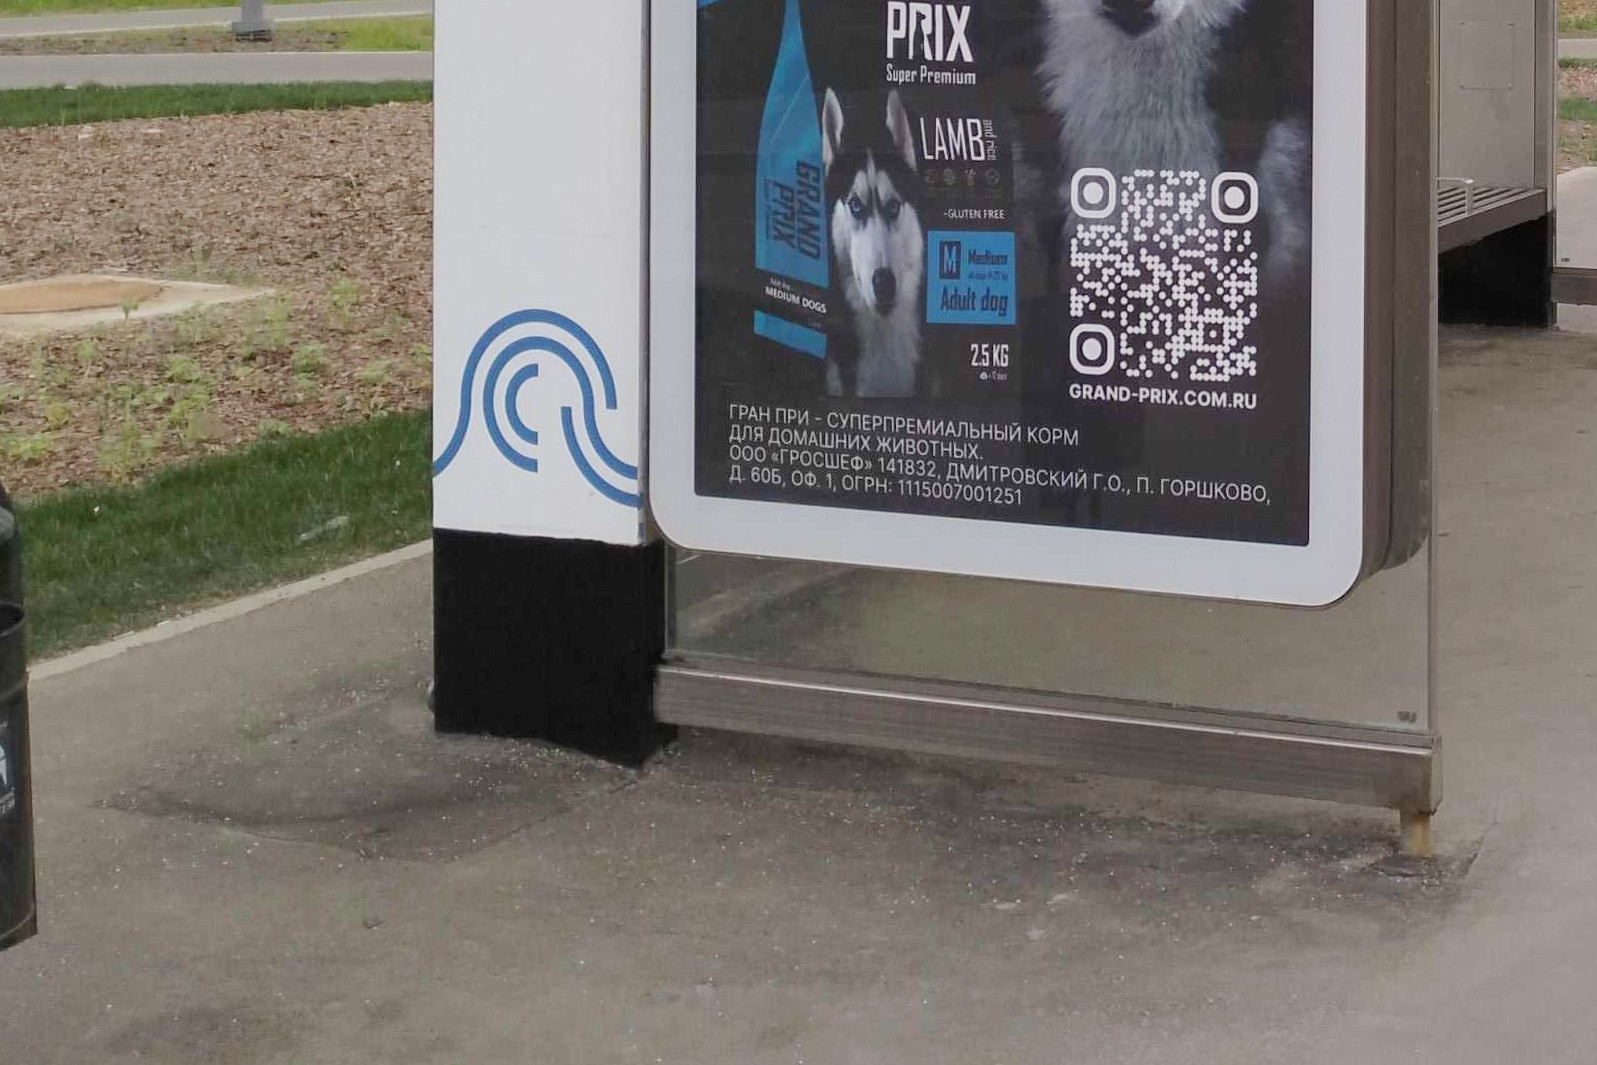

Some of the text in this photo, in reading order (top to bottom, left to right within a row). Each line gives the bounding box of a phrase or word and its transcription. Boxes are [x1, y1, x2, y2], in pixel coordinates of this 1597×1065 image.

[886, 1, 974, 62] PRIX
[886, 63, 977, 85] Super Premium
[920, 117, 985, 161] LAMB
[983, 209, 1006, 220] FREE
[942, 244, 958, 274] M
[765, 286, 828, 314] MEDIUM DOGS
[940, 286, 1009, 316] Adult dog
[970, 343, 1009, 368] 2.5 KG
[1068, 383, 1258, 410] GRAND-PRIX.COM.RU
[728, 403, 771, 422] ГРАН
[775, 407, 810, 426] ПРИ
[826, 411, 1022, 442] СУПЕРПРЕМИАЛЬНЫЙ
[1027, 427, 1080, 447] КОРМ
[728, 424, 984, 460] ДЛЯ ДОМАШНИХ ЖИВОТНЫХ.
[728, 465, 746, 485] Д.
[791, 470, 820, 488] ОФ.
[825, 473, 837, 492] 1,
[841, 475, 893, 494] ОГРН:
[898, 479, 1022, 506] 1115007001251
[729, 444, 1271, 505] ООО «ГРОСШЕФ» 141832, ДМИТРОВСКИЙ Г.О., П. ГОРШКОВО,
